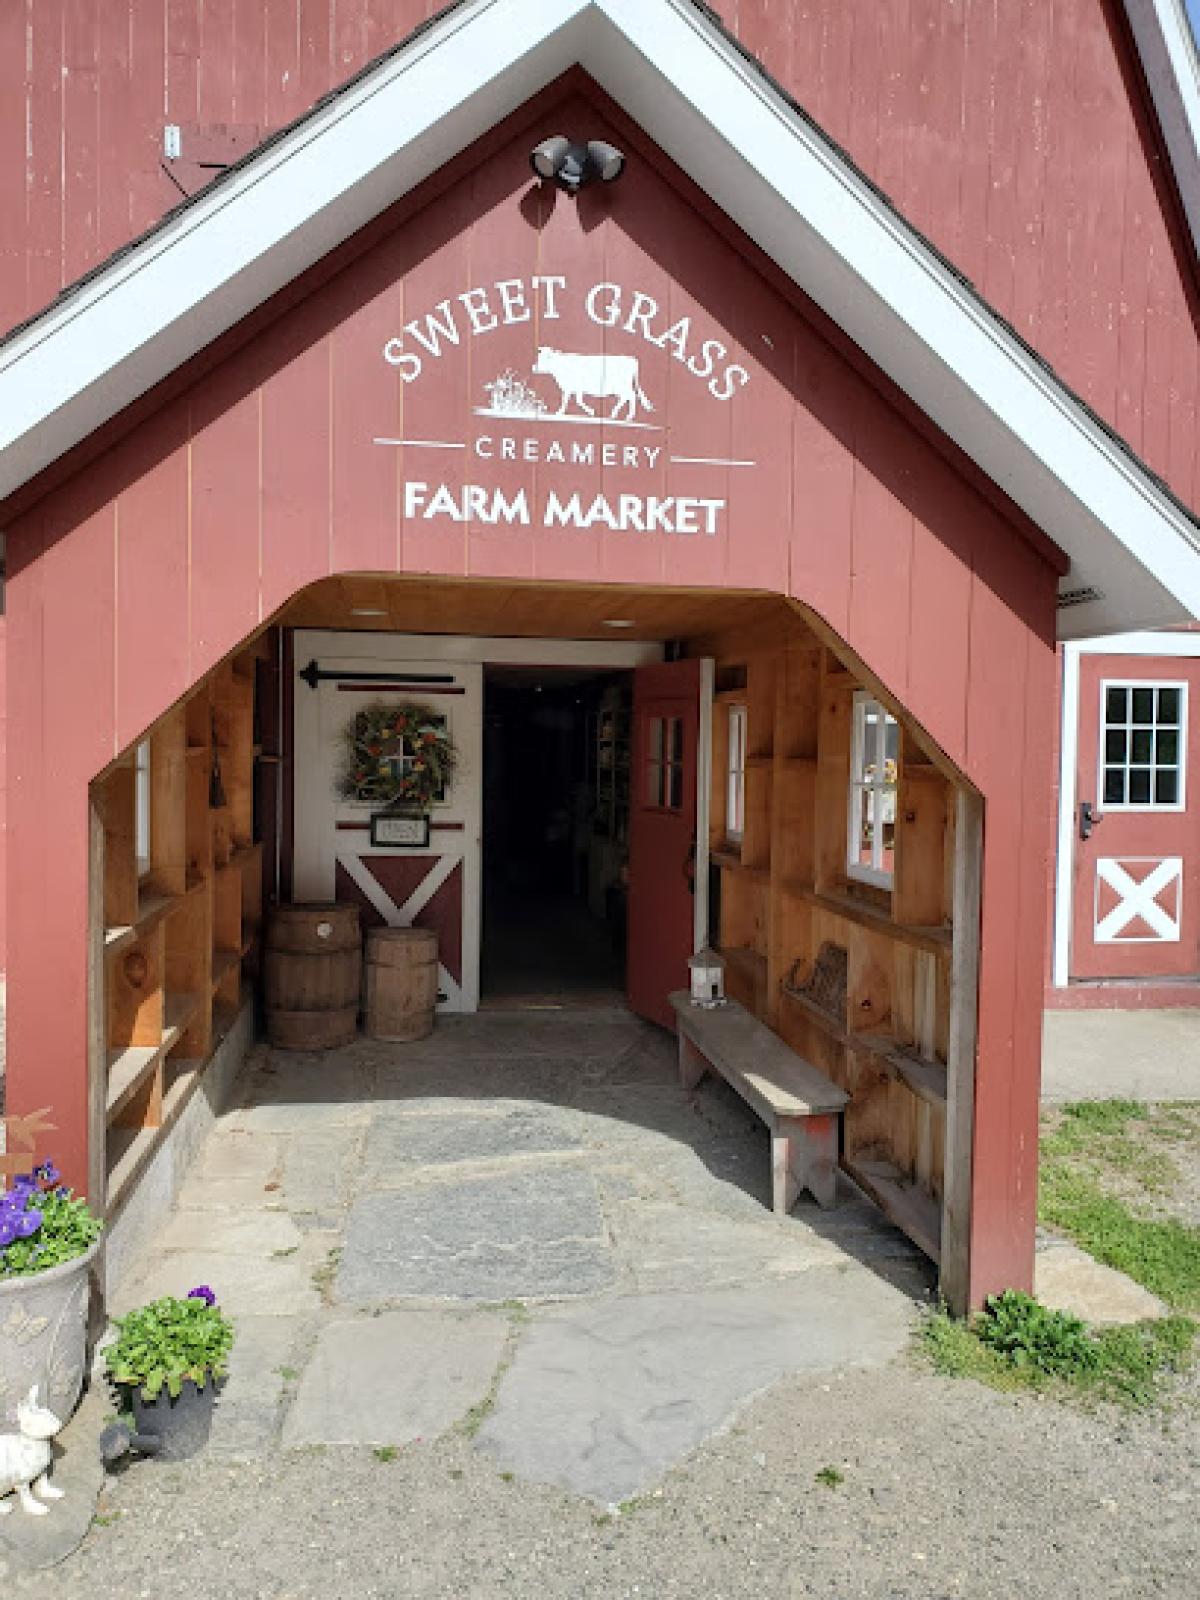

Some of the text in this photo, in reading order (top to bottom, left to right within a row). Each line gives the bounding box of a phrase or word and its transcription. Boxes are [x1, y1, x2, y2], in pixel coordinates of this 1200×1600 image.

[383, 276, 750, 400] SWEET GRASS
[475, 435, 662, 468] CREAMERY
[404, 482, 726, 534] FARM MARKET
